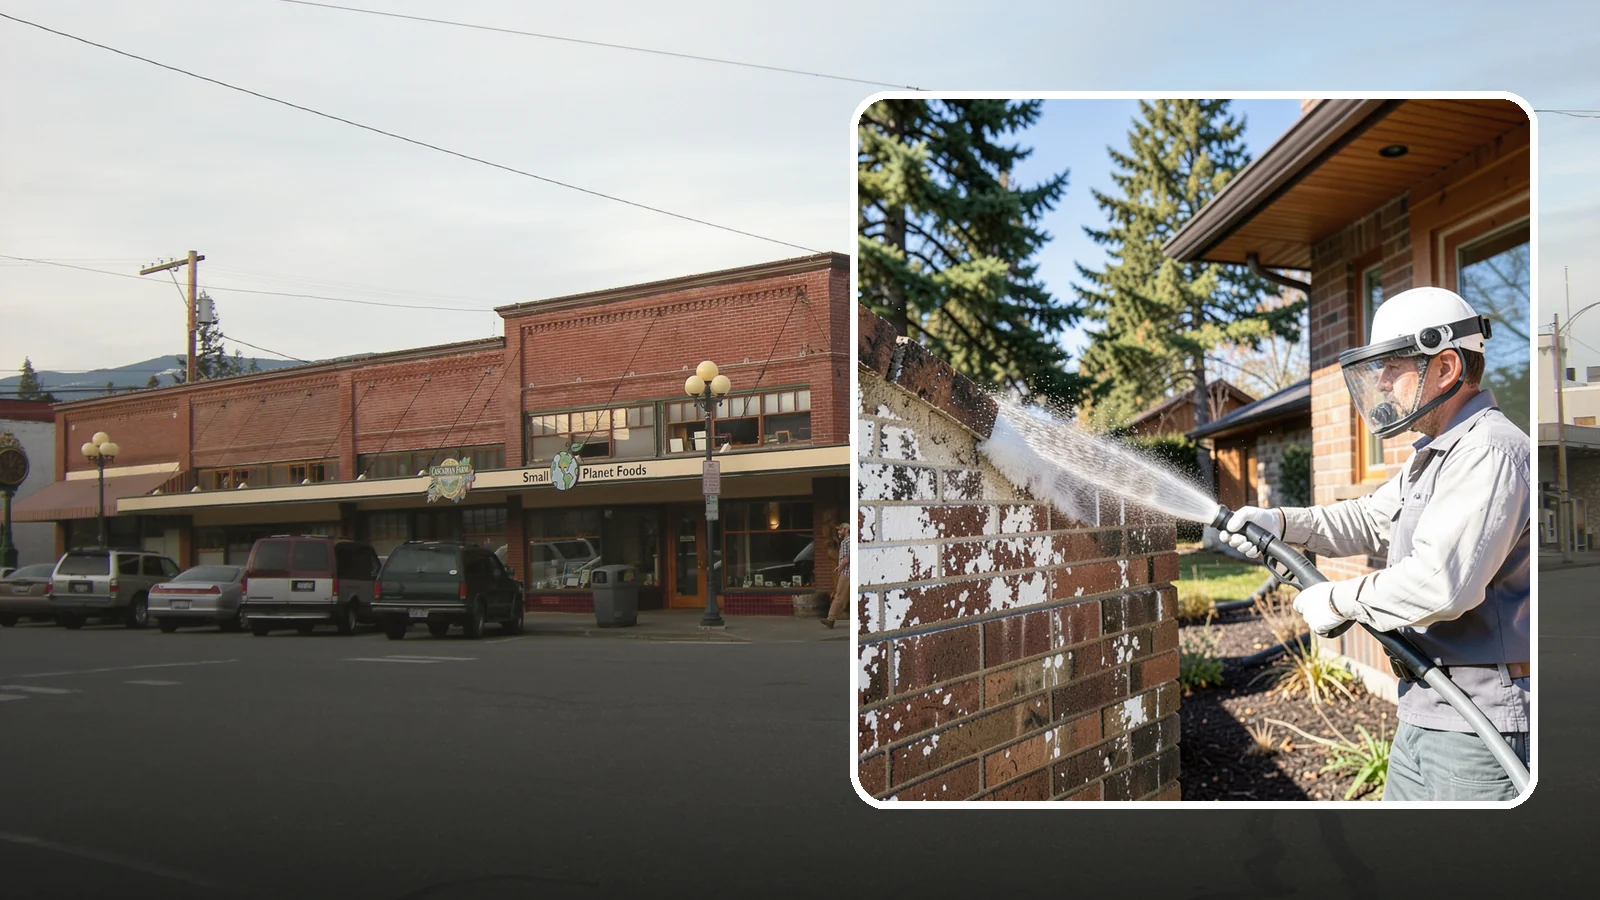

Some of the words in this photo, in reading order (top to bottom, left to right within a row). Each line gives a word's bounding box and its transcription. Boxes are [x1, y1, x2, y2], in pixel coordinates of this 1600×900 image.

[523, 471, 549, 483] Small
[583, 467, 614, 479] Planet
[616, 464, 647, 477] Foods
